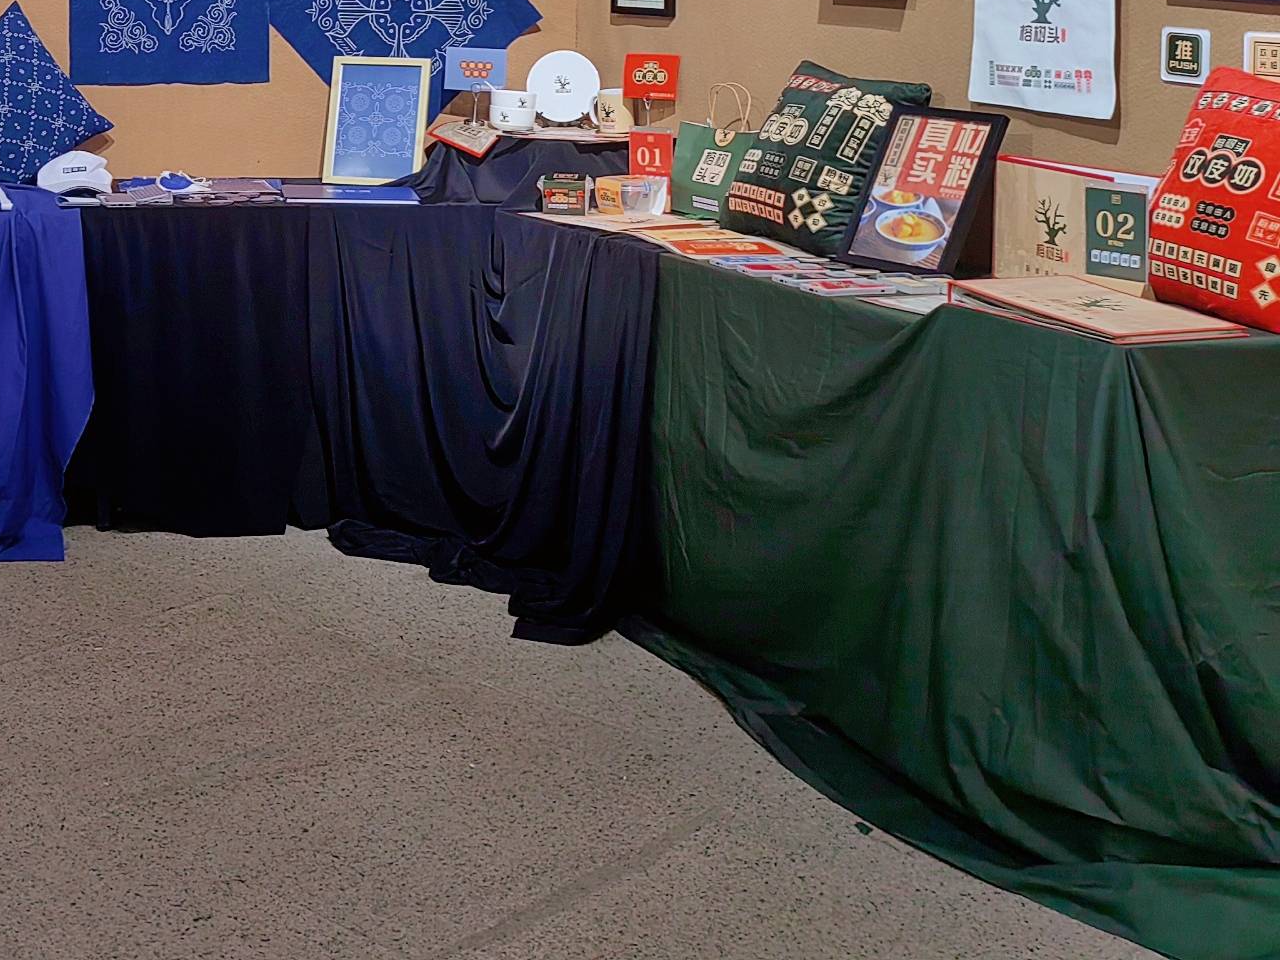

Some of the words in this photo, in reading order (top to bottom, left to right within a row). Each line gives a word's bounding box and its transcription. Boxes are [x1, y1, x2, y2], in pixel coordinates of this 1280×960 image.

[1019, 24, 1060, 44] 榕树头
[1175, 40, 1193, 60] 推
[1169, 60, 1198, 71] PUSH
[636, 146, 662, 167] 01
[1184, 154, 1258, 188] 双皮奶
[1096, 210, 1135, 240] 02
